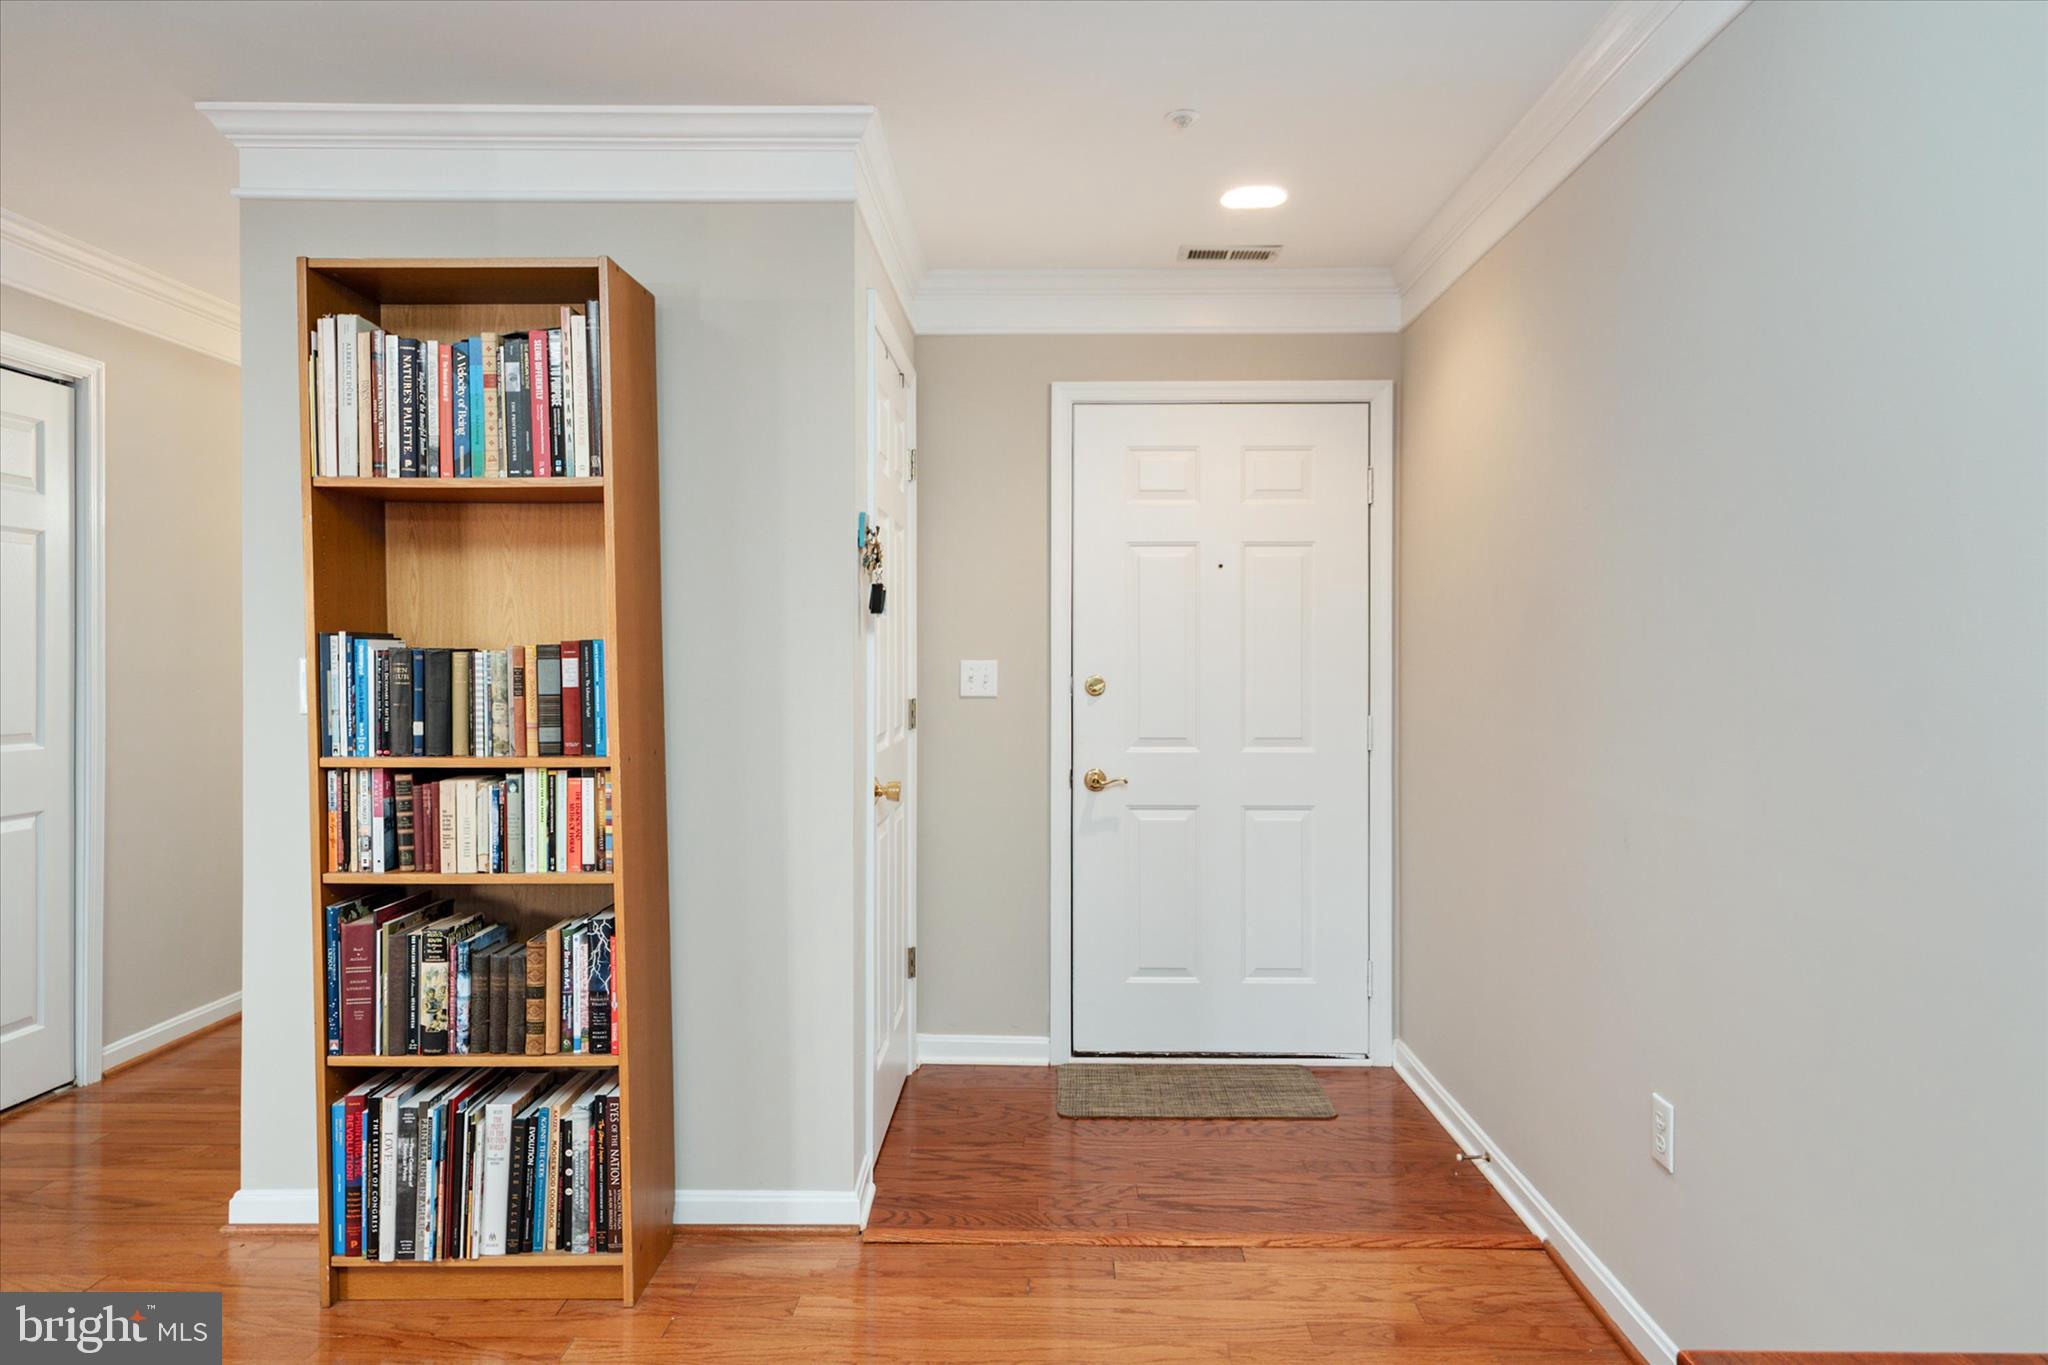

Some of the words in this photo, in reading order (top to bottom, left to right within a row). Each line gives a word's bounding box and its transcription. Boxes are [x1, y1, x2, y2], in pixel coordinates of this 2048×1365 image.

[456, 352, 466, 360] A
[534, 340, 542, 360] SEEING
[402, 354, 412, 404] NATURE'S
[456, 362, 466, 398] Velocity
[534, 362, 544, 400] DIFFERENTLY
[458, 398, 467, 410] of
[455, 410, 466, 436] Being
[610, 1102, 619, 1122] EYES
[611, 1124, 618, 1132] OF
[384, 1132, 393, 1161] LOVE
[420, 1118, 428, 1183] PRINTMAKING
[512, 1136, 521, 1184] MARBLE
[528, 1126, 536, 1166] EVOLUTION
[610, 1149, 620, 1186] NATION
[372, 1178, 378, 1188] OF
[420, 1186, 426, 1196] IN
[511, 1194, 519, 1233] HALLS
